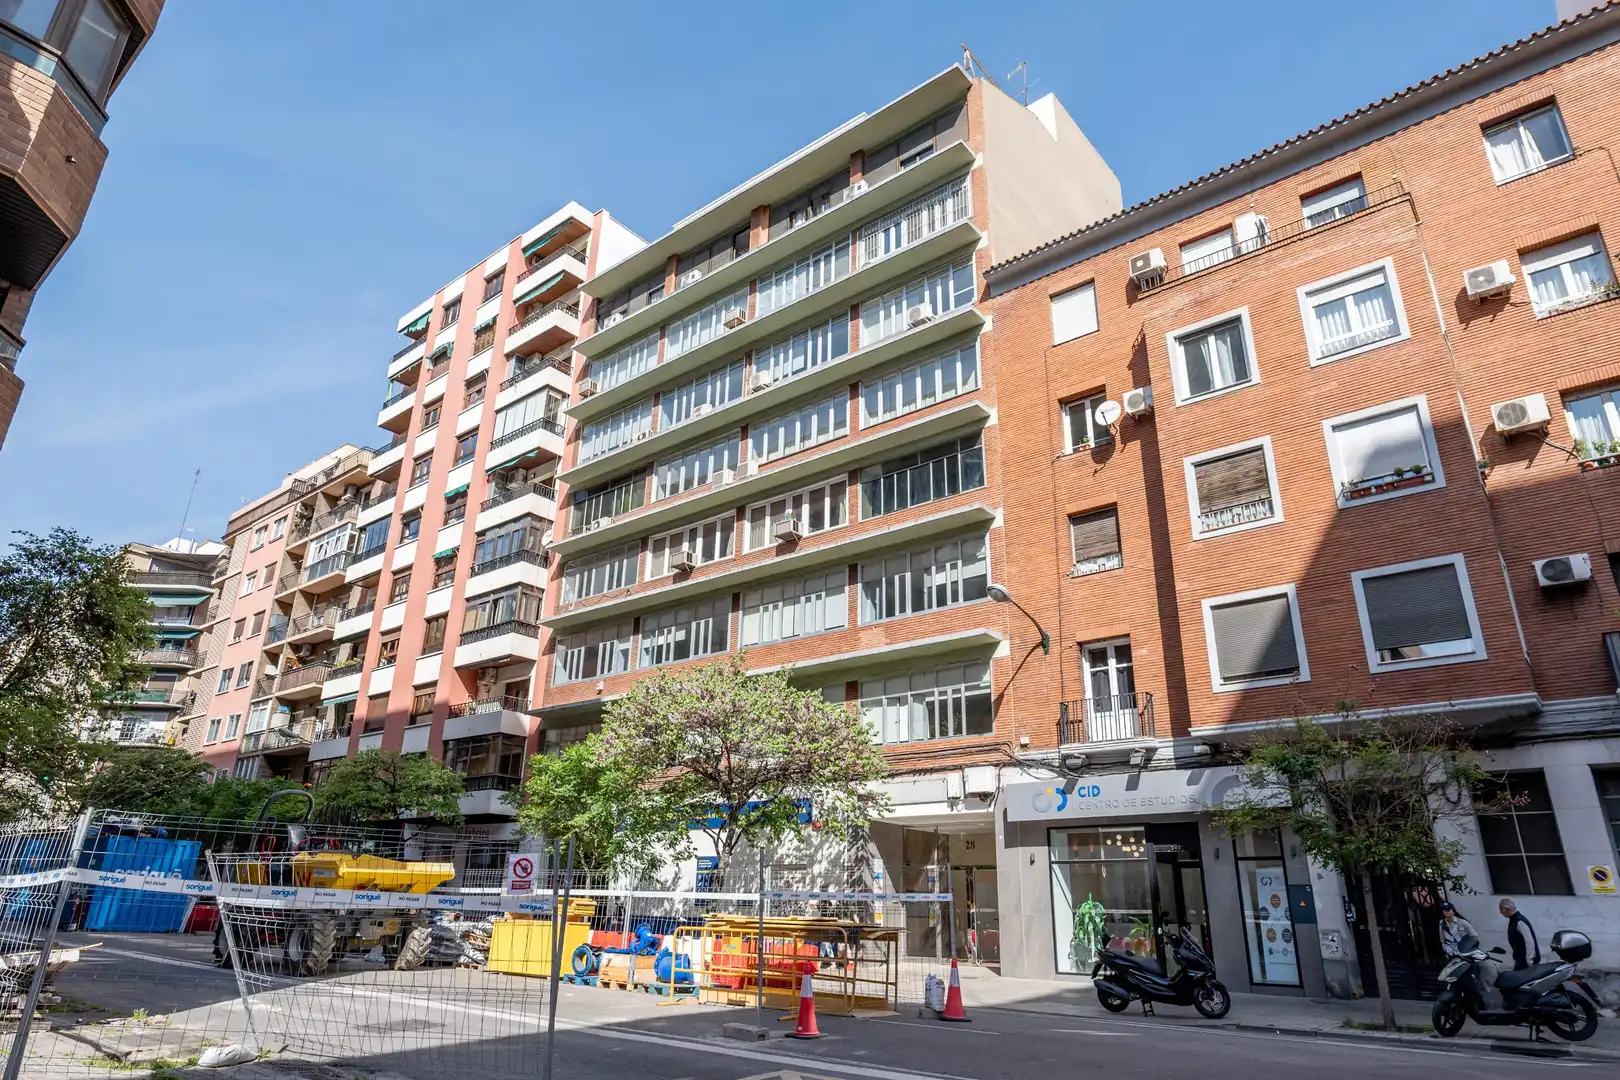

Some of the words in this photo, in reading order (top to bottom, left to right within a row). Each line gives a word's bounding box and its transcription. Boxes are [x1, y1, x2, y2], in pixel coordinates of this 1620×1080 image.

[1078, 785, 1100, 798] CID
[1079, 799, 1119, 810] CENTRO
[1123, 798, 1136, 808] DE
[1140, 794, 1196, 807] ESTUDIOS
[965, 840, 976, 850] 28
[186, 882, 213, 892] sorigué
